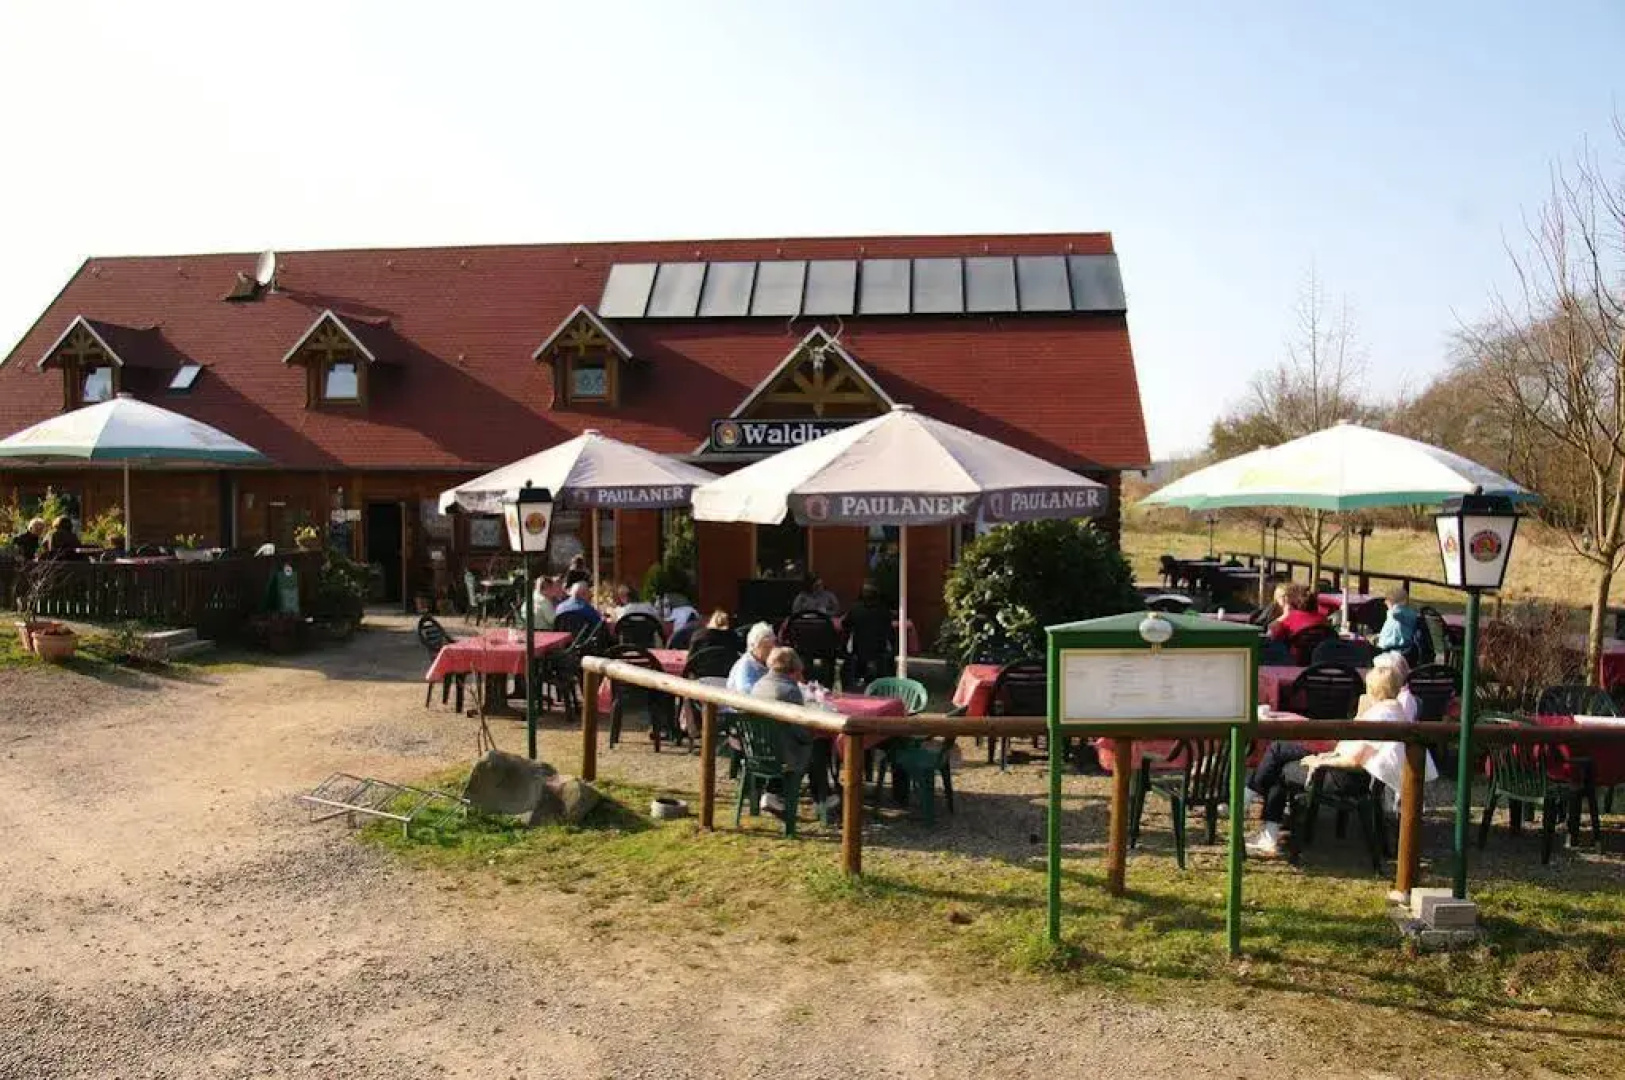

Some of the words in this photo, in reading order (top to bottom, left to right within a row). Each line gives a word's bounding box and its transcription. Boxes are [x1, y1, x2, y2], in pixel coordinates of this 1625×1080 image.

[599, 487, 685, 503] PAULANER
[1010, 488, 1100, 511] PAULANER
[841, 496, 968, 516] PAULANER
